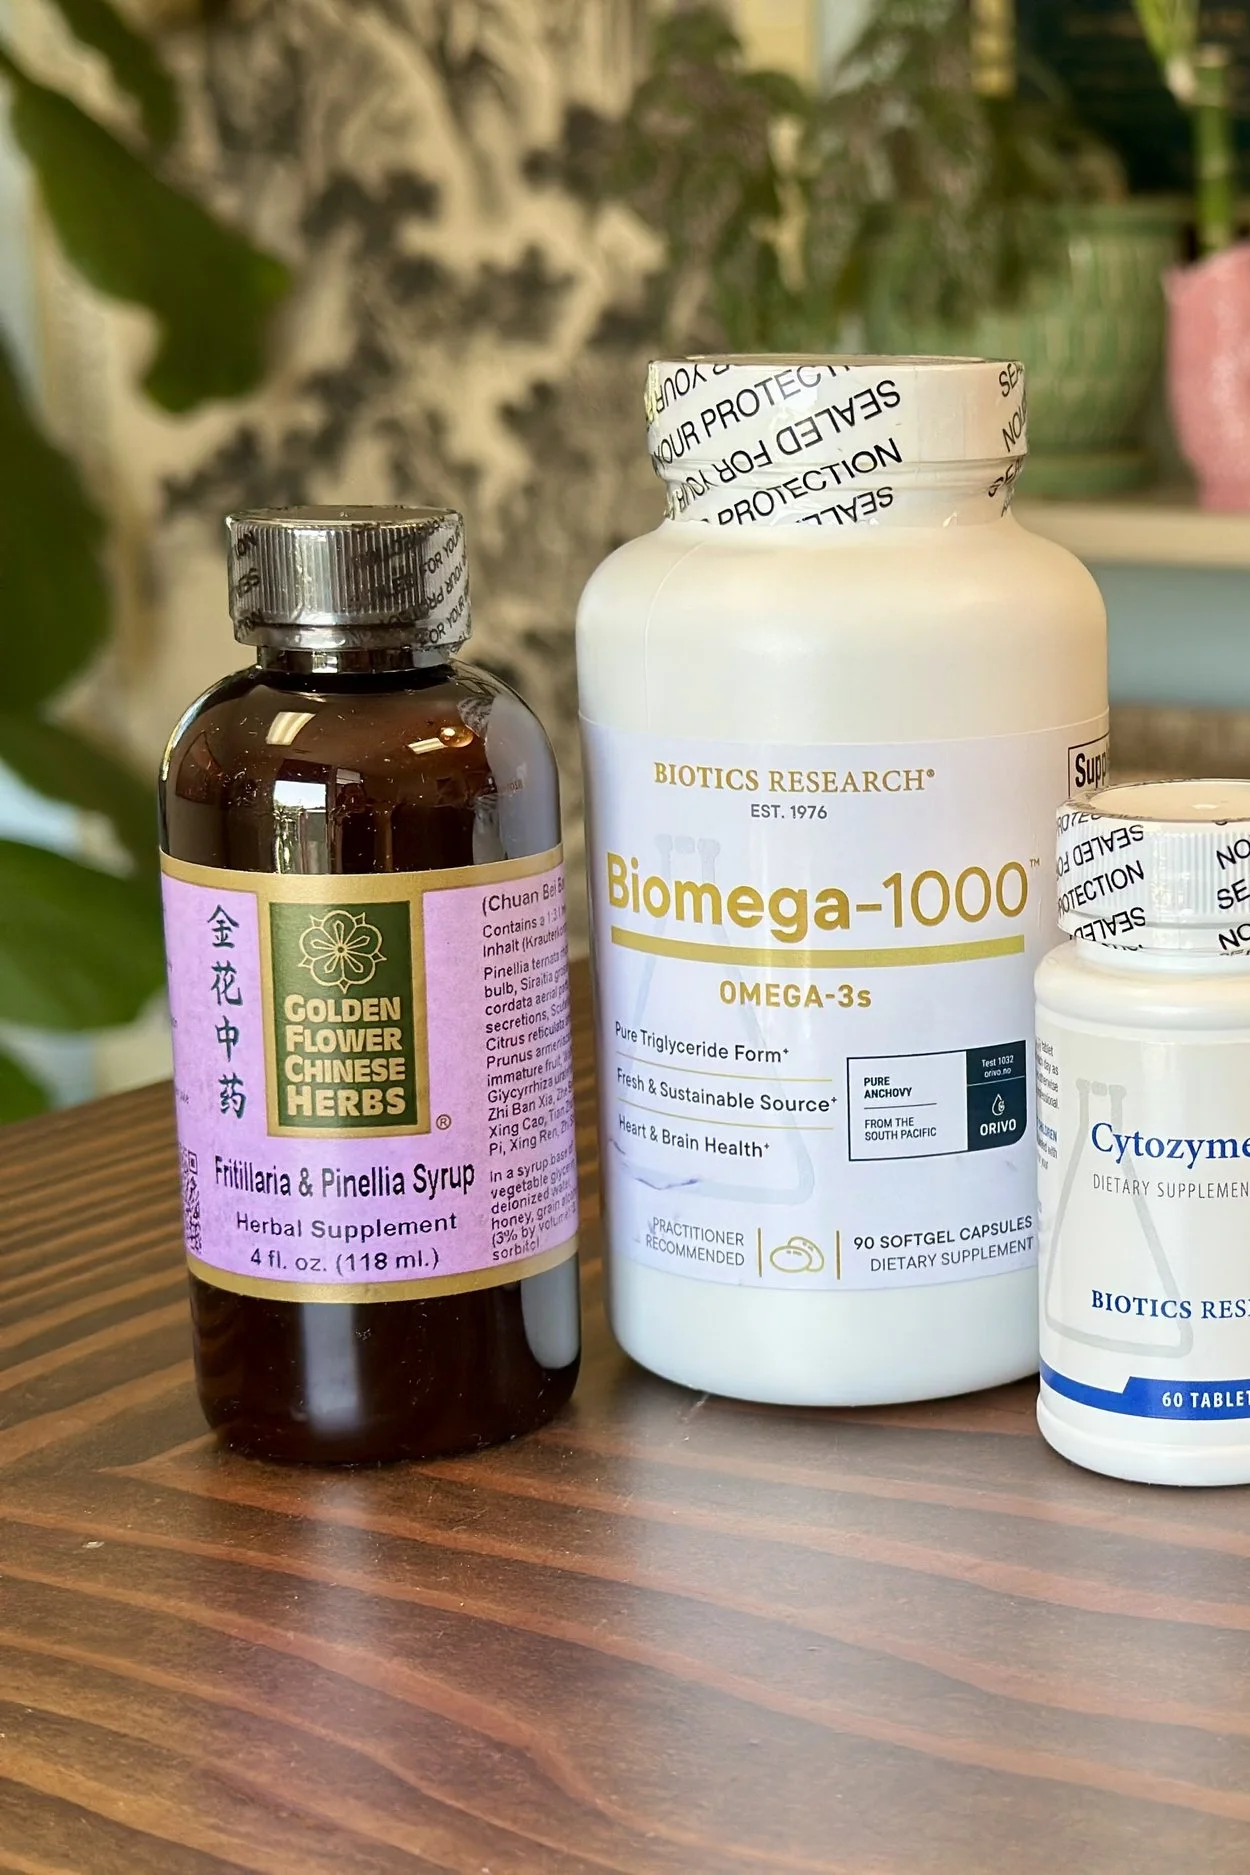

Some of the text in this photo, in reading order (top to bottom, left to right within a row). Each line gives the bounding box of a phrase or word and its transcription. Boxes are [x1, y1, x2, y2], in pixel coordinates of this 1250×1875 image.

[776, 379, 901, 456] SEALED
[711, 439, 773, 484] FOR
[718, 437, 903, 525] PROTECTION
[654, 762, 760, 791] BIOTICS
[751, 804, 828, 820] EST. 1976
[1073, 824, 1144, 867] SEALED
[482, 890, 539, 917] (Chuan
[483, 918, 538, 938] Contains
[483, 939, 520, 958] Inhalt
[483, 961, 530, 981] Pinellia
[484, 981, 518, 998] bulb,
[719, 980, 873, 1008] OMEGA-3s
[207, 904, 248, 1120] 金花中药
[284, 994, 401, 1023] GOLDEN
[485, 997, 533, 1016] cordata
[485, 1010, 550, 1034] secretions,
[285, 1025, 403, 1053] FLOWER
[486, 1033, 525, 1051] Citrus
[615, 1021, 638, 1043] Pure
[640, 1029, 729, 1060] Triglyceride
[284, 1055, 406, 1083] CHINESE
[486, 1050, 533, 1069] Prunus
[982, 1055, 1014, 1068] Test 1032
[487, 1064, 543, 1087] immature
[863, 1076, 891, 1087] PURE
[287, 1085, 406, 1117] HERBS
[617, 1068, 645, 1093] Fresh
[648, 1078, 657, 1096] &
[660, 1082, 755, 1110] Sustainable
[864, 1087, 913, 1099] ANCHOVY
[488, 1106, 509, 1122] Zhi
[512, 1100, 536, 1116] Ban
[864, 1117, 914, 1129] FROM THE
[489, 1123, 519, 1139] Xing
[522, 1115, 547, 1131] Cao,
[618, 1114, 646, 1139] Heart
[649, 1127, 659, 1142] &
[662, 1129, 699, 1151] Brain
[865, 1127, 937, 1141] SOUTH PACIFIC
[979, 1118, 1017, 1136] ORIVO
[489, 1142, 506, 1157] Pi,
[510, 1133, 537, 1152] Xing
[215, 1155, 475, 1200] Fritillaria & Pinellia Syrup
[490, 1171, 502, 1182] In
[506, 1168, 514, 1179] a
[517, 1158, 548, 1178] syrup
[491, 1174, 548, 1199] vegetable
[1093, 1173, 1149, 1196] DIETARY
[491, 1188, 549, 1214] deionized
[236, 1211, 457, 1243] Herbal Supplement
[491, 1211, 534, 1231] honey,
[653, 1217, 744, 1247] PRACTITIONER
[854, 1215, 1032, 1250] 90 SOFTGEL CAPSULES
[492, 1223, 536, 1249] (3% by
[250, 1248, 439, 1276] 4 fl. oz. (118 ml.)
[646, 1234, 745, 1266] RECOMMENDED
[871, 1236, 1034, 1272] DIETARY SUPPLEMENT
[1091, 1289, 1192, 1320] BIOTICS
[1162, 1392, 1184, 1408] 60
